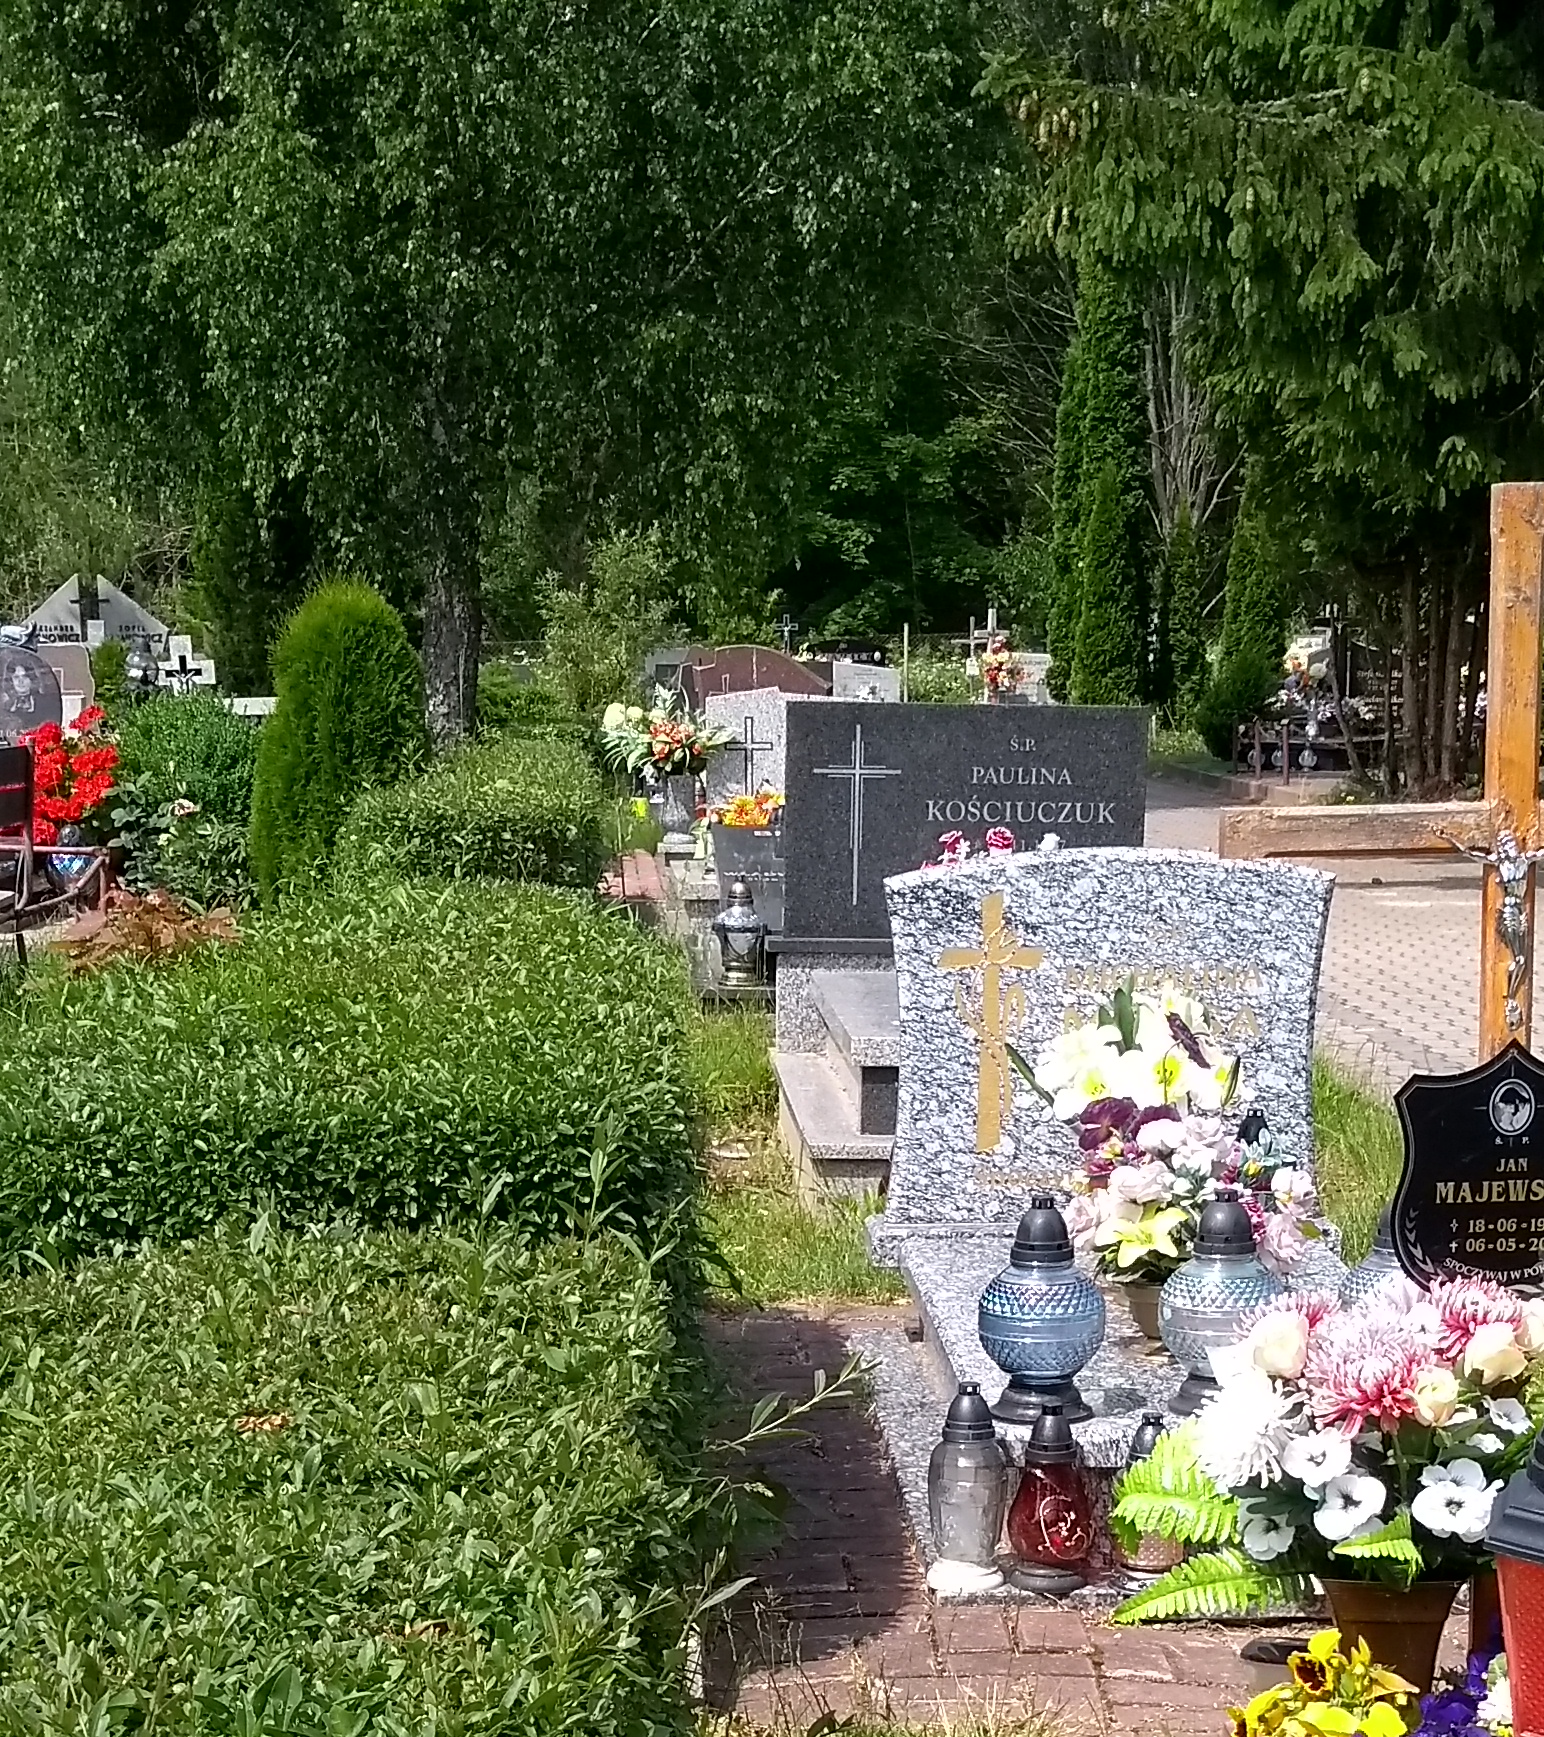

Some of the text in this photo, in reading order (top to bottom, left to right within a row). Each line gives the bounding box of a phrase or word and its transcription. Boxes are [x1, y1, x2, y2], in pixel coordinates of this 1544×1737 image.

[971, 766, 1073, 785] PAULINA
[925, 795, 1116, 824] KOŚCIUCZUK
[1496, 1158, 1529, 1172] JAN
